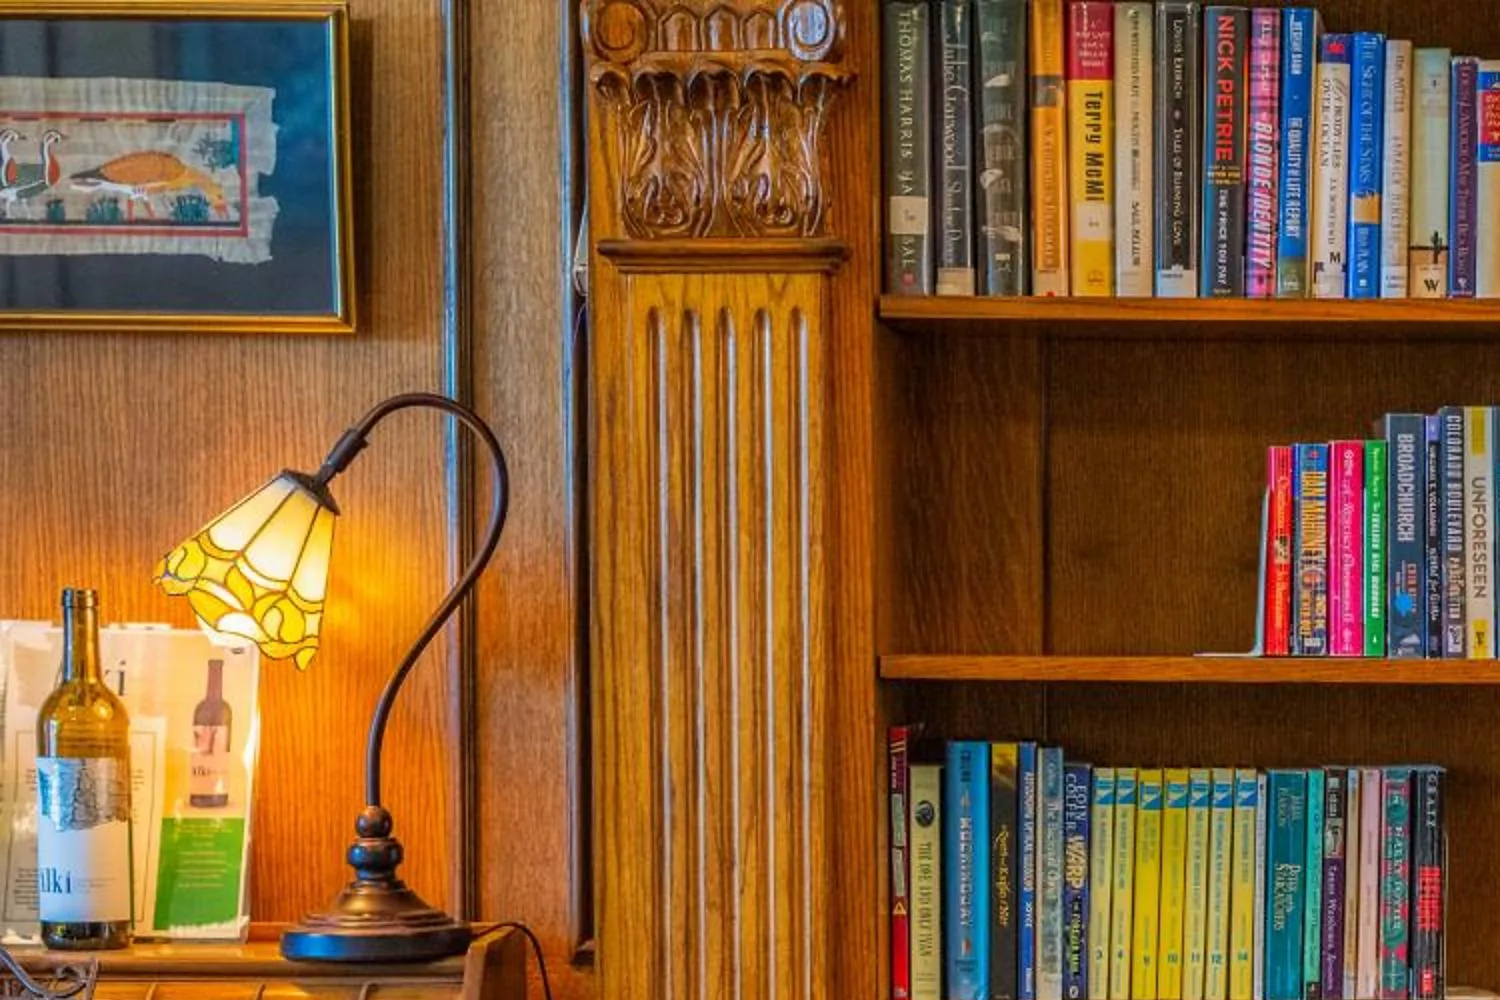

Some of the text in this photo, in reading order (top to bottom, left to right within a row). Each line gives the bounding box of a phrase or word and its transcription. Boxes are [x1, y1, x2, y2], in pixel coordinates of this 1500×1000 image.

[898, 9, 914, 158] THOMAS HARRIS
[1216, 15, 1234, 161] NICK PETRIE
[1360, 64, 1375, 99] SIGHT
[1361, 38, 1377, 59] THE
[944, 35, 968, 169] Julie Garwood
[1085, 92, 1103, 144] Terry
[1360, 102, 1373, 117] OF
[1252, 121, 1272, 269] BLONDE IDENTITY
[1285, 129, 1302, 238] QUALITY LIFE REPORT
[1360, 149, 1374, 183] STARS
[1218, 211, 1228, 239] PRICE
[1302, 471, 1326, 496] DAN
[1397, 434, 1415, 542] BROADCHURCH
[1447, 415, 1462, 552] COLORADO BOULEVARD
[1471, 477, 1487, 599] UNFORESEEN
[1065, 836, 1085, 888] WARP
